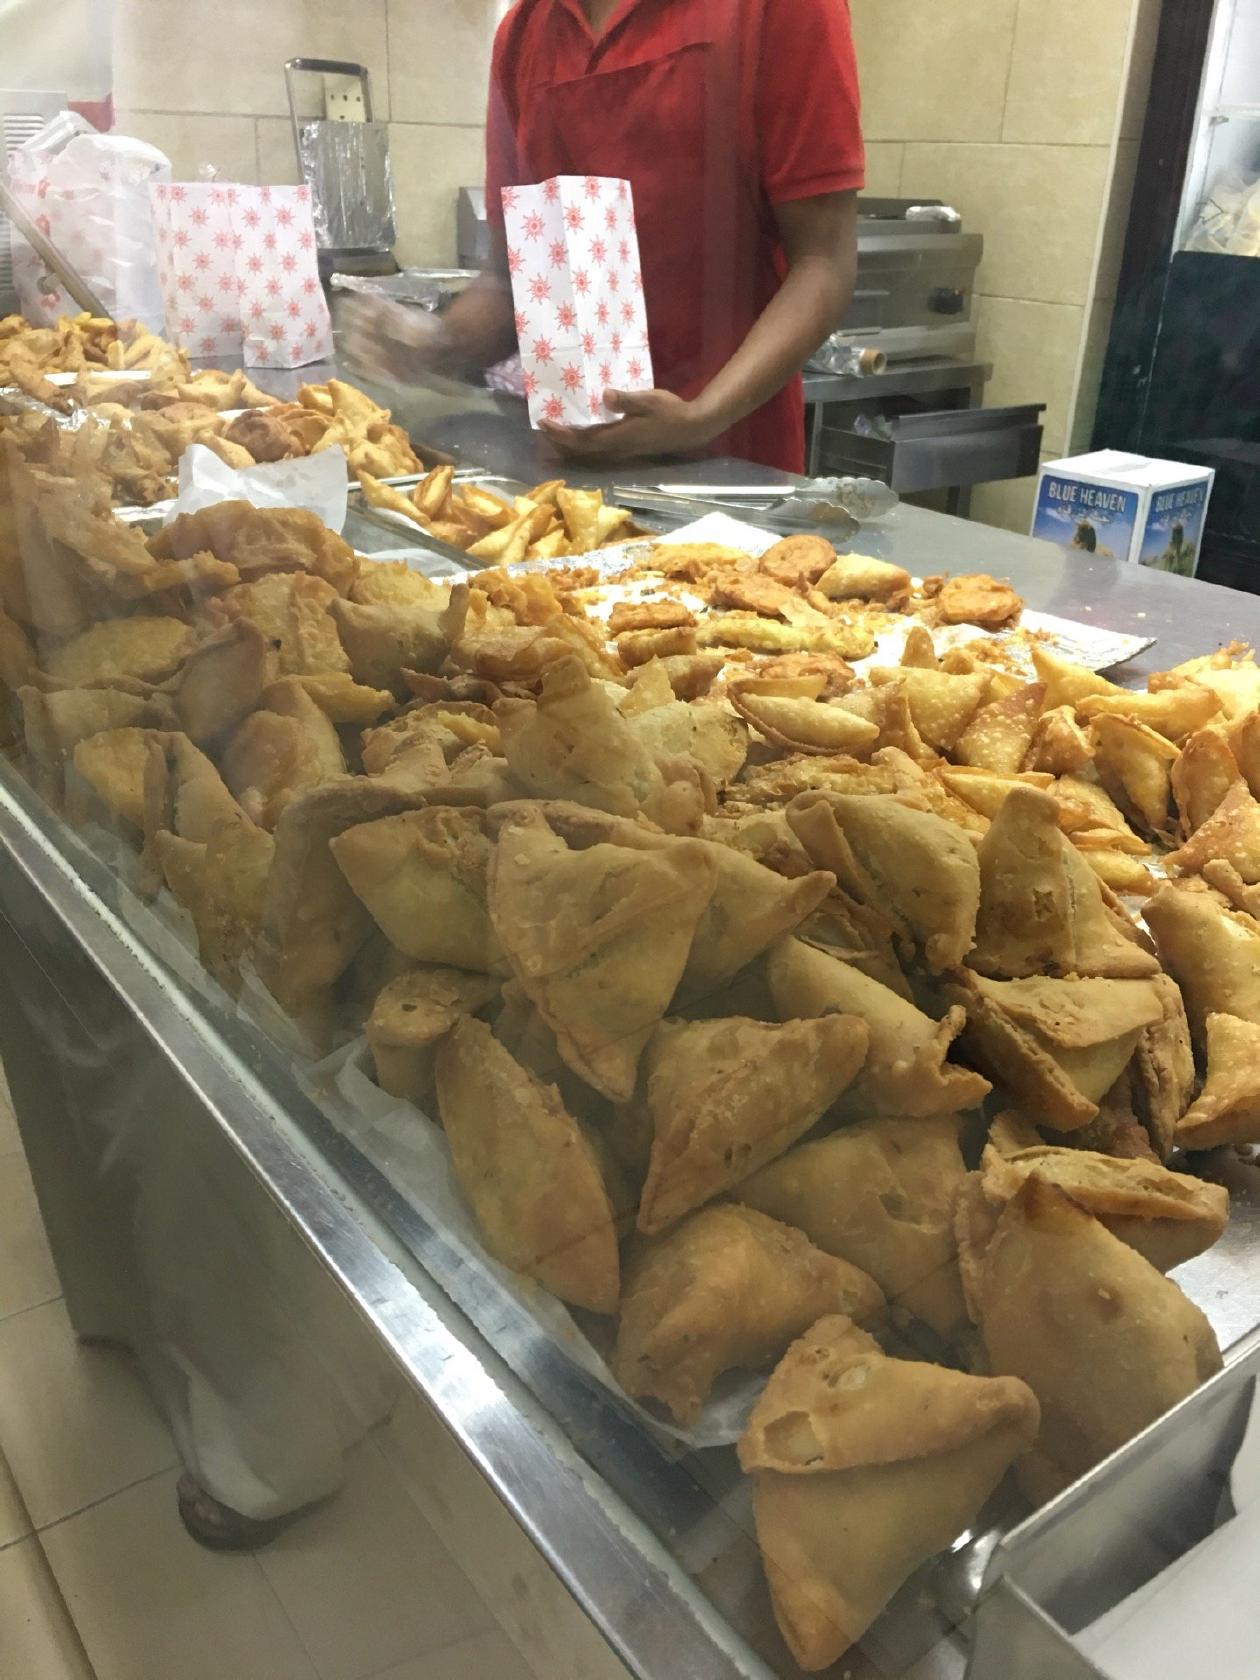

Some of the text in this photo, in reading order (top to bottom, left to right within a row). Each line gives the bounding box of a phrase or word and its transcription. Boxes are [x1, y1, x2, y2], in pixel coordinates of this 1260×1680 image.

[1048, 482, 1127, 512] BLUE HEAVEN
[1155, 487, 1204, 512] BLUE HEAVEN
